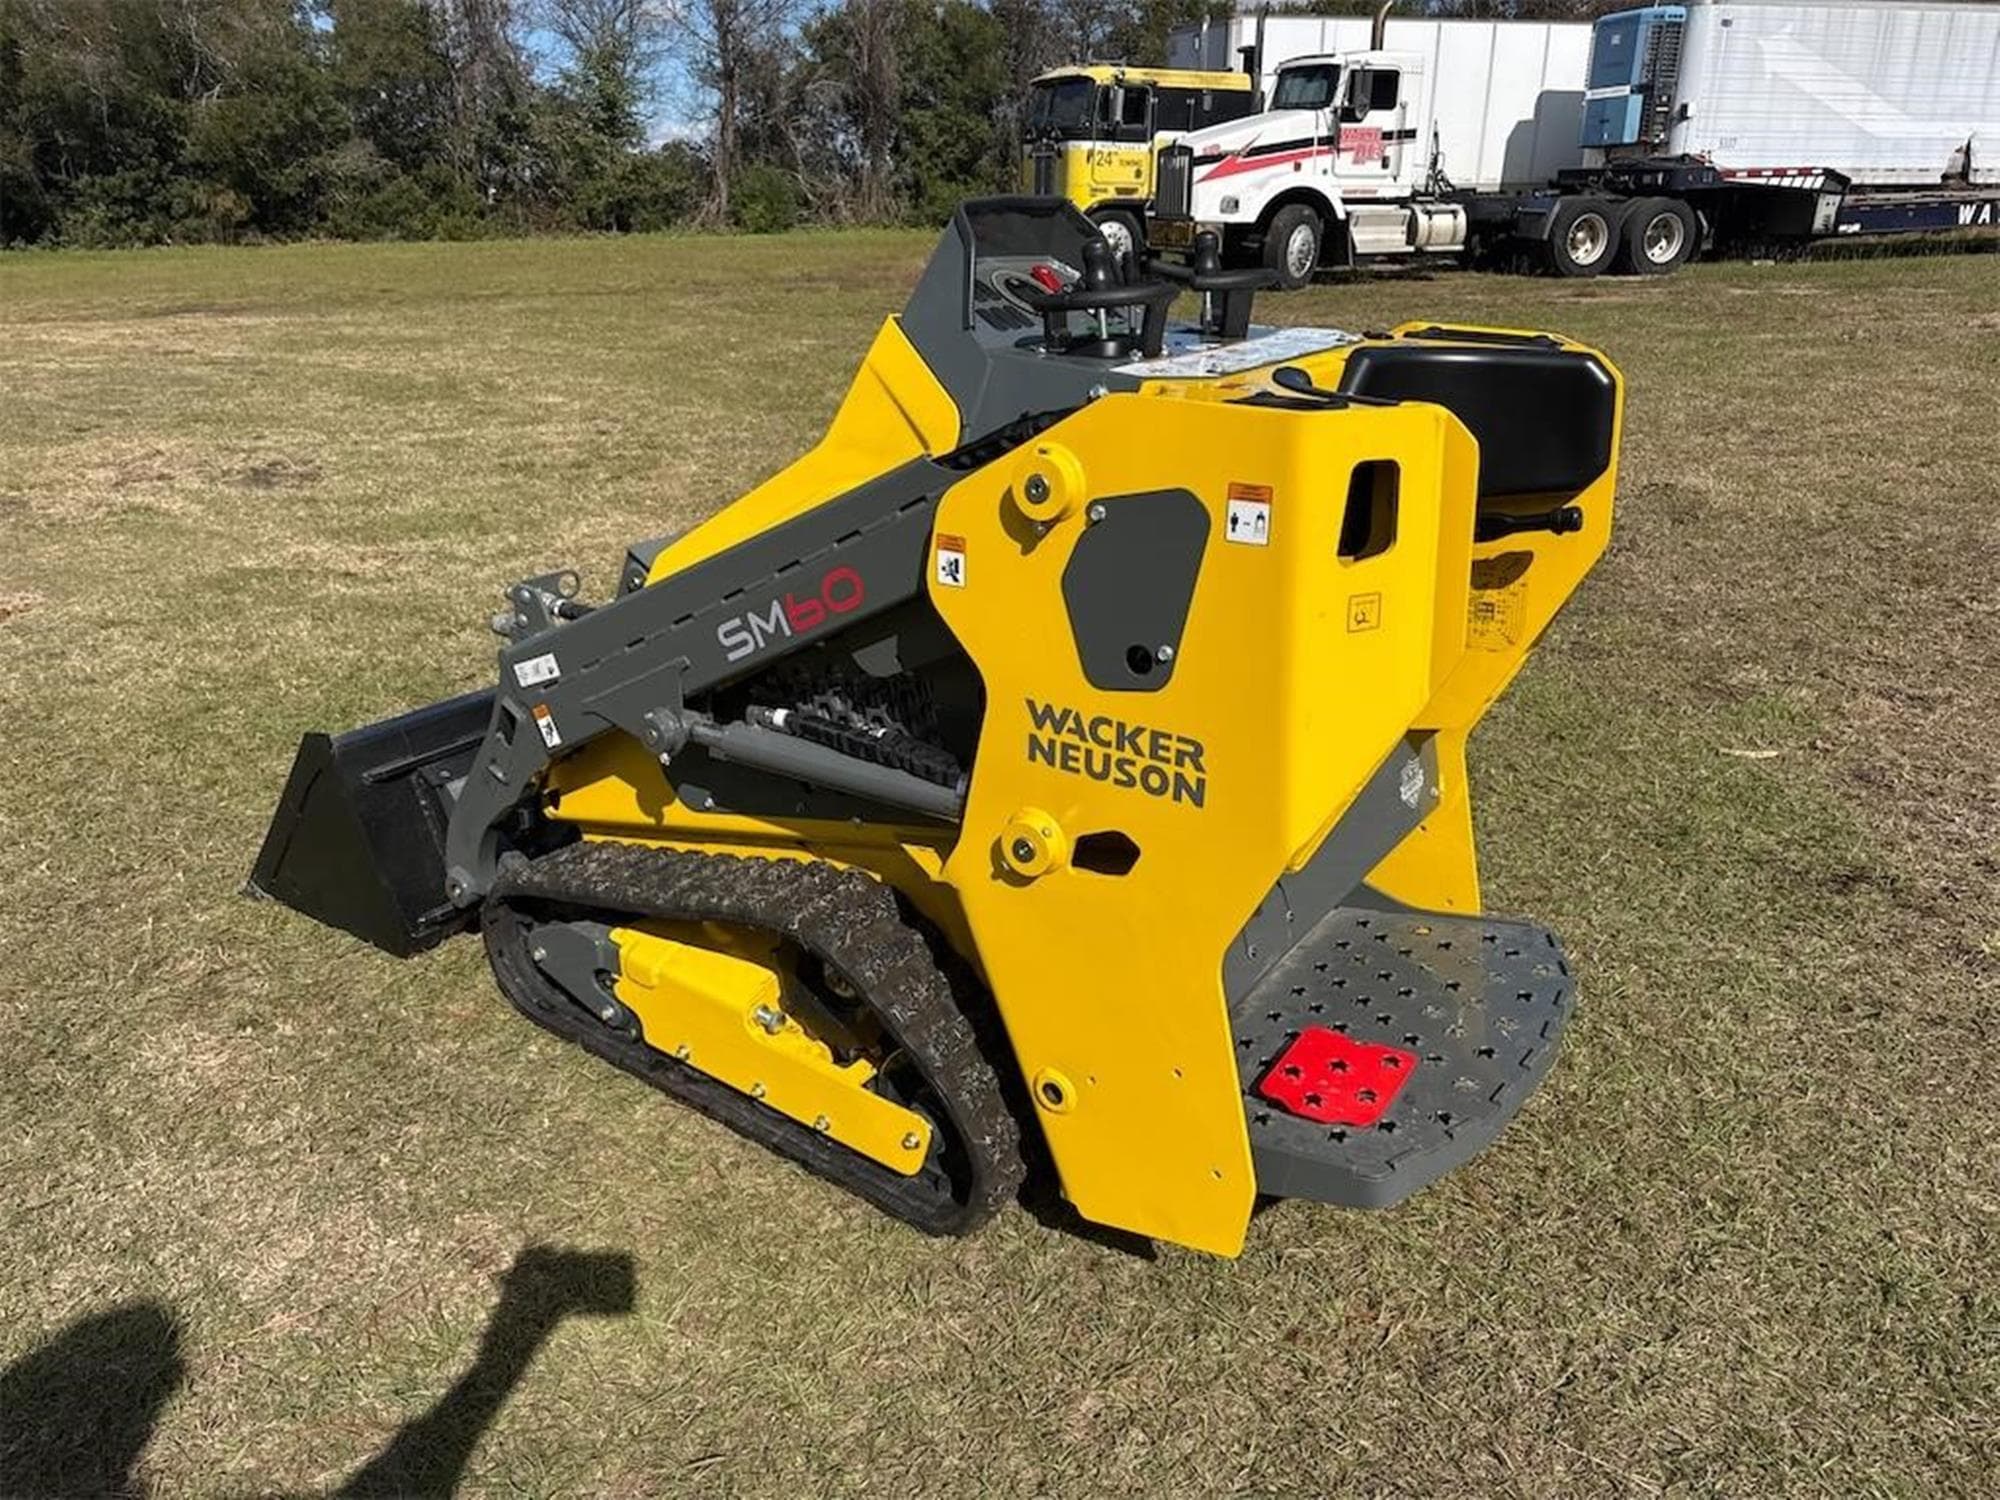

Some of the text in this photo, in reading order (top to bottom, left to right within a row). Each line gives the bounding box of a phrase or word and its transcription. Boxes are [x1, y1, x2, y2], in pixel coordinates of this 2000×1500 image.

[1958, 202, 2000, 225] WA
[717, 566, 865, 662] SM60
[1025, 697, 1206, 774] WACKER
[1028, 733, 1206, 809] NEUSON
